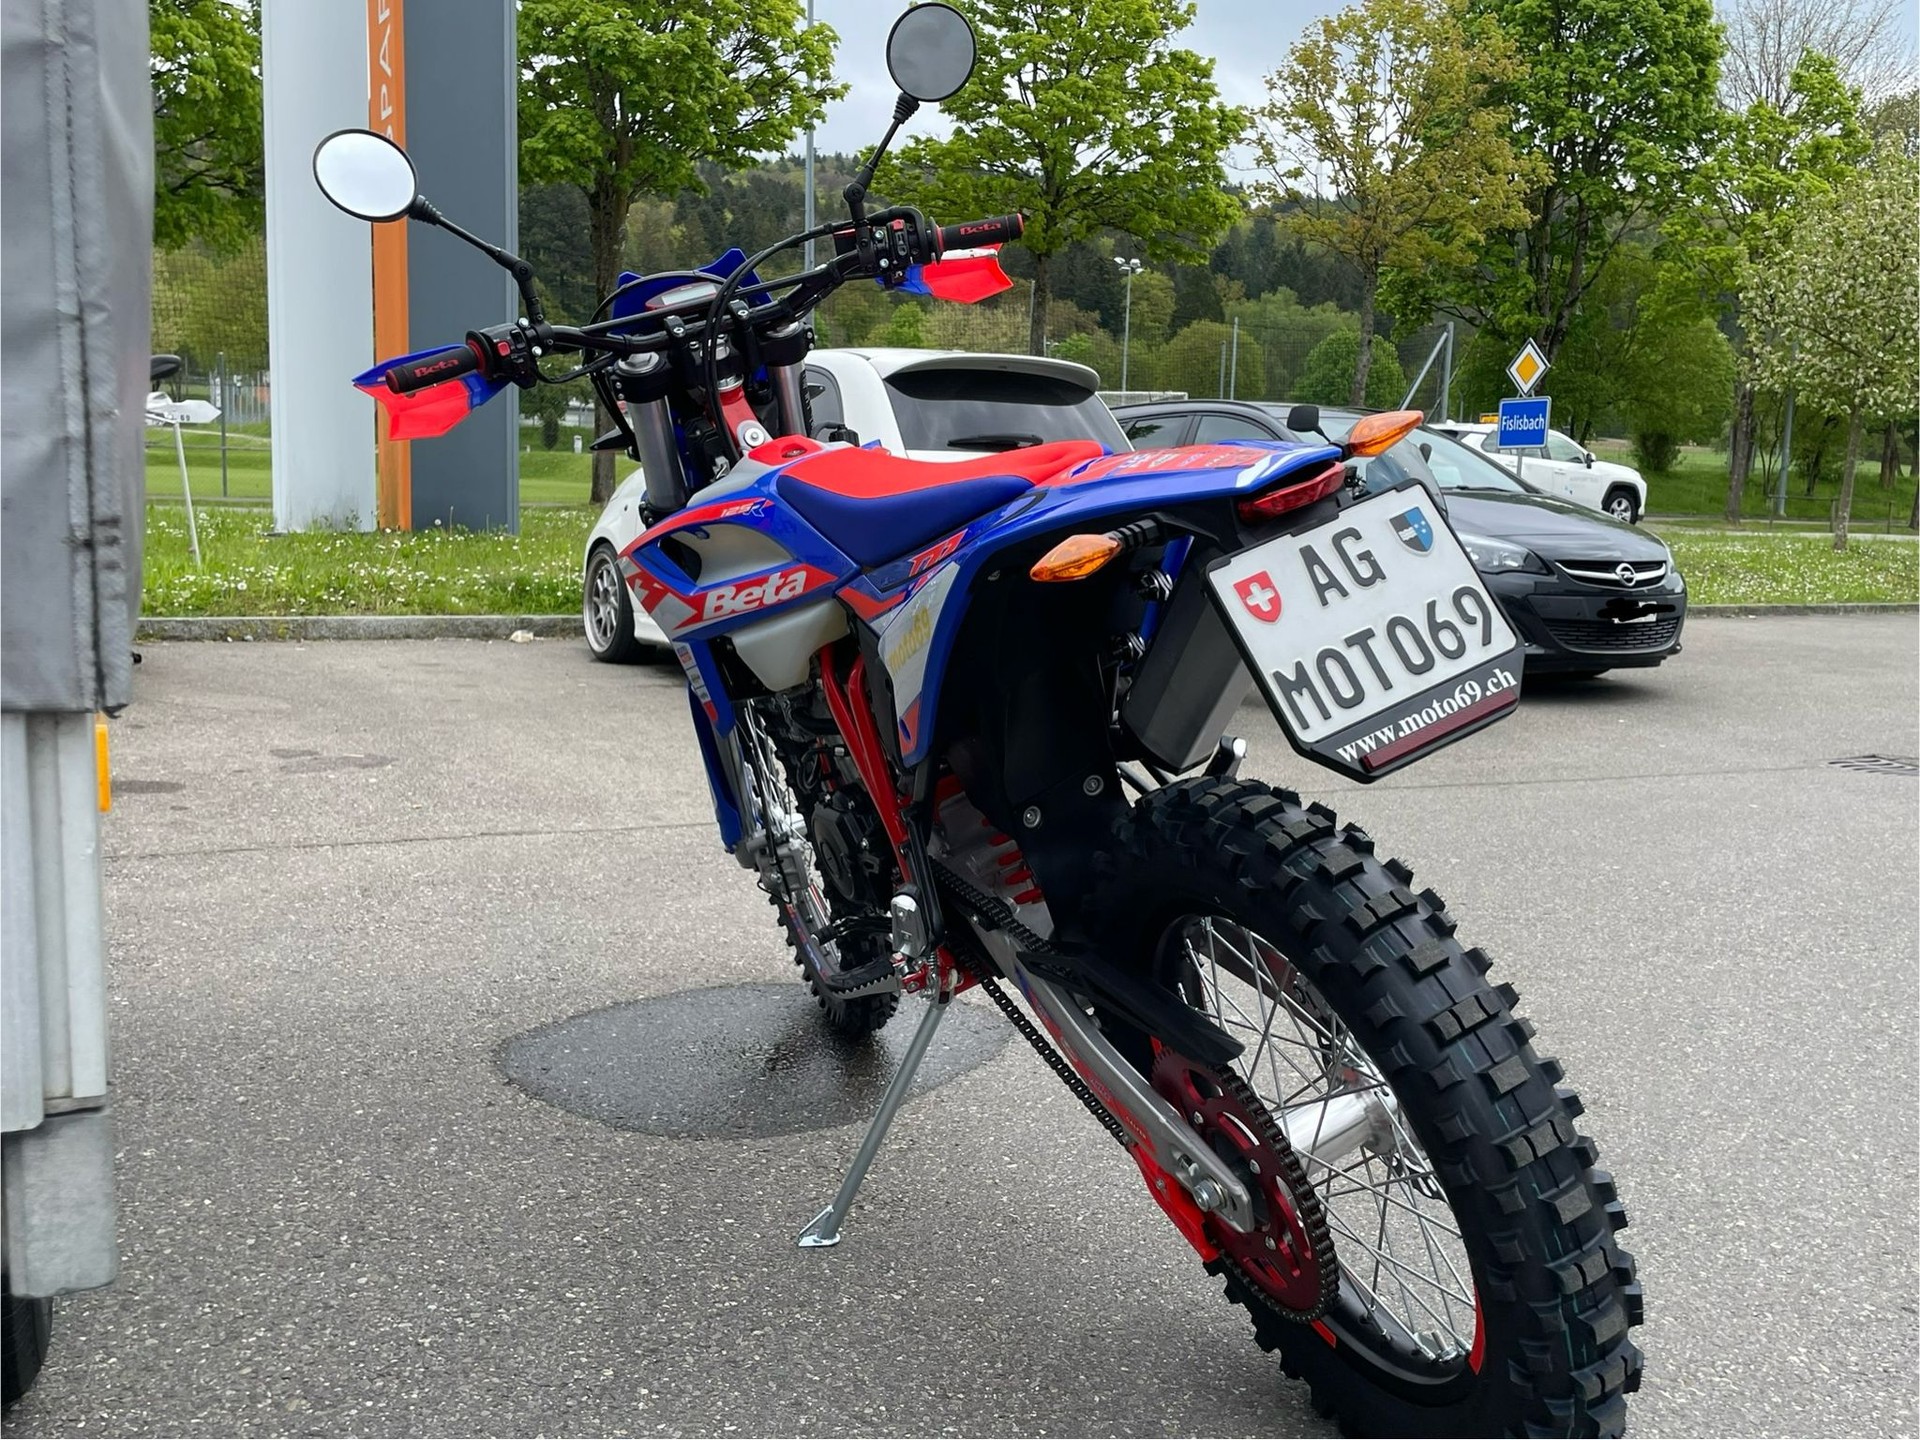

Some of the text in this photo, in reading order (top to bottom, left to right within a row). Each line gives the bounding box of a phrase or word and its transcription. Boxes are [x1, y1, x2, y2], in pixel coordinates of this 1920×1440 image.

[960, 223, 1001, 235] Beta
[414, 359, 459, 378] Beta
[1501, 413, 1545, 432] Fislisbach
[1299, 526, 1386, 606] AG
[702, 570, 807, 620] Beta
[1272, 586, 1492, 730] MOTO69
[1336, 668, 1517, 763] www.moto69.ch
